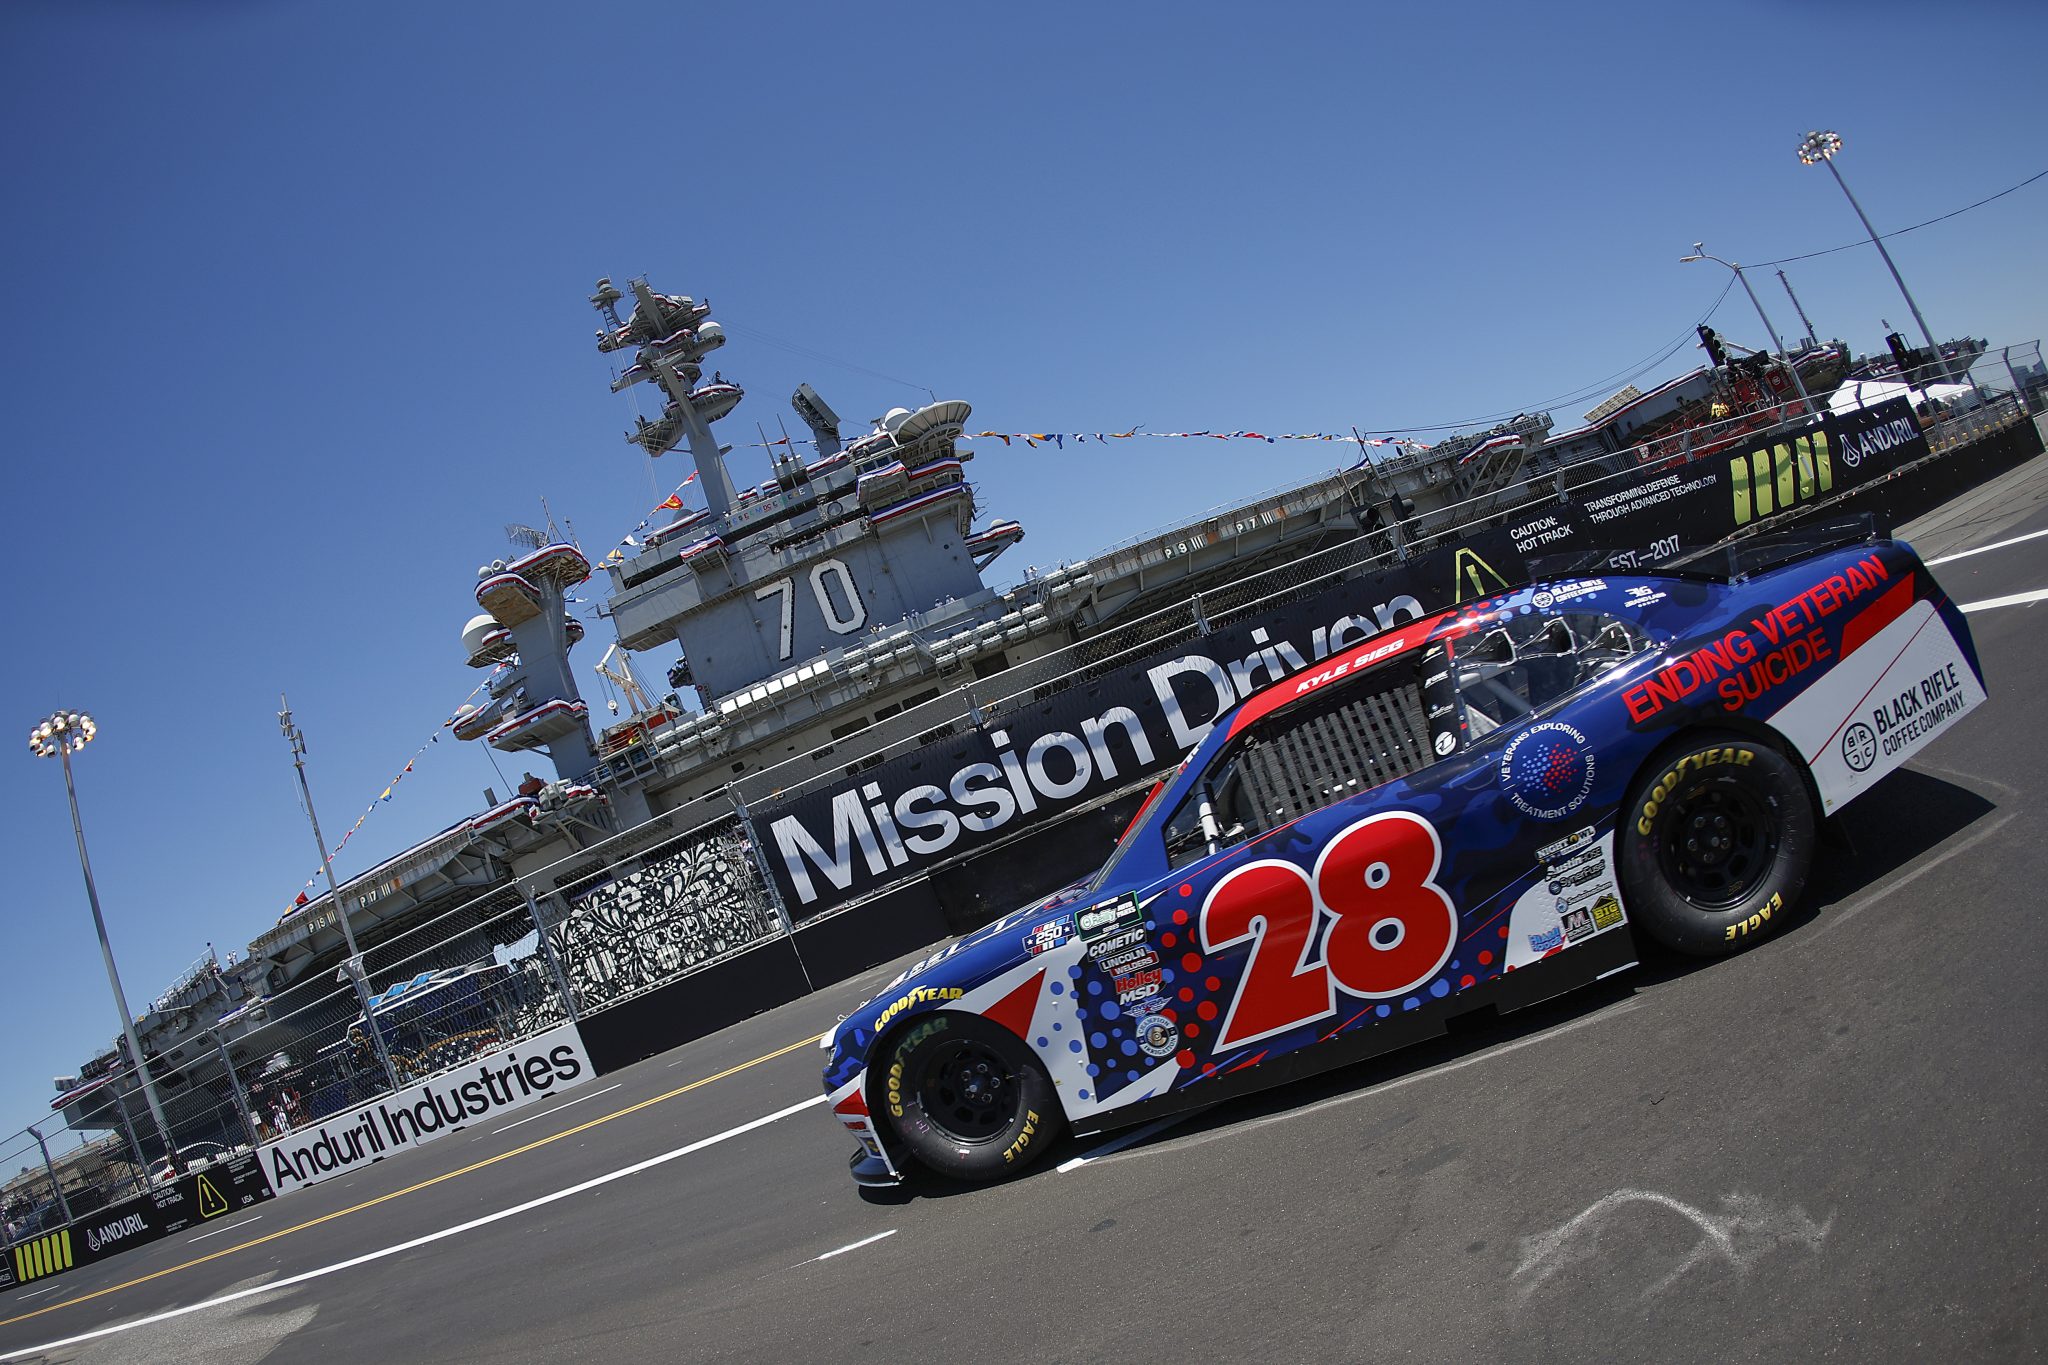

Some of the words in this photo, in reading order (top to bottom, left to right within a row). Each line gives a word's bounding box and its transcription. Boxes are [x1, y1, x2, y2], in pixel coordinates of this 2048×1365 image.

[1857, 417, 1919, 458] ANDURIL
[1584, 485, 1647, 513] TRANSFORMING
[1646, 474, 1681, 493] DEFENSE
[1589, 504, 1631, 524] THROUGH
[1631, 490, 1671, 511] ADVANCED
[1670, 474, 1717, 497] TECHNOLOGY
[1236, 523, 1244, 534] P
[1250, 518, 1257, 529] 7
[1510, 516, 1558, 540] CAUTION:
[1516, 537, 1538, 554] HOT
[1538, 524, 1573, 544] TRACK
[1164, 548, 1173, 559] P
[1177, 543, 1188, 553] 9
[1551, 582, 1581, 596] BLACK
[754, 558, 868, 660] 70
[1621, 629, 1758, 724] ENDING
[1751, 554, 1889, 645] VETERAN
[1296, 662, 1350, 694] KYLE
[1353, 638, 1405, 668] SIEG
[1718, 627, 1832, 712] SUICIDE
[1873, 686, 1923, 735] BLACK
[1920, 662, 1960, 706] RIFLE
[1882, 719, 1921, 756] COFFEE
[1919, 690, 1966, 733] COMPANY
[1501, 731, 1530, 782] VETERANS
[1530, 722, 1586, 744] EXPLORING
[770, 706, 1156, 905] Mission
[1510, 792, 1568, 819] TREATMENT
[1568, 754, 1595, 811] SOLUTIONS
[1637, 747, 1755, 836] GOODYEAR
[1536, 840, 1569, 858] NIGHT
[1594, 902, 1618, 918] BIG
[1725, 891, 1783, 941] EAGLE
[1035, 928, 1063, 945] 250
[1088, 927, 1145, 957] COMETIC
[1200, 811, 1458, 1056] 28
[1101, 948, 1146, 970] LINCOLN
[1115, 956, 1154, 975] WELDERS
[1115, 967, 1163, 994] Holley
[1119, 983, 1160, 1006] MSD
[874, 984, 964, 1032] GOODYEAR
[272, 1110, 386, 1189] Anduril
[380, 1045, 582, 1146] Industries
[1003, 1109, 1040, 1163] EAGLE
[152, 1186, 176, 1201] CAUTION:
[156, 1198, 167, 1209] HOT
[166, 1193, 184, 1205] TRACK
[241, 1194, 255, 1205] USA
[100, 1212, 148, 1245] ANDURIL
